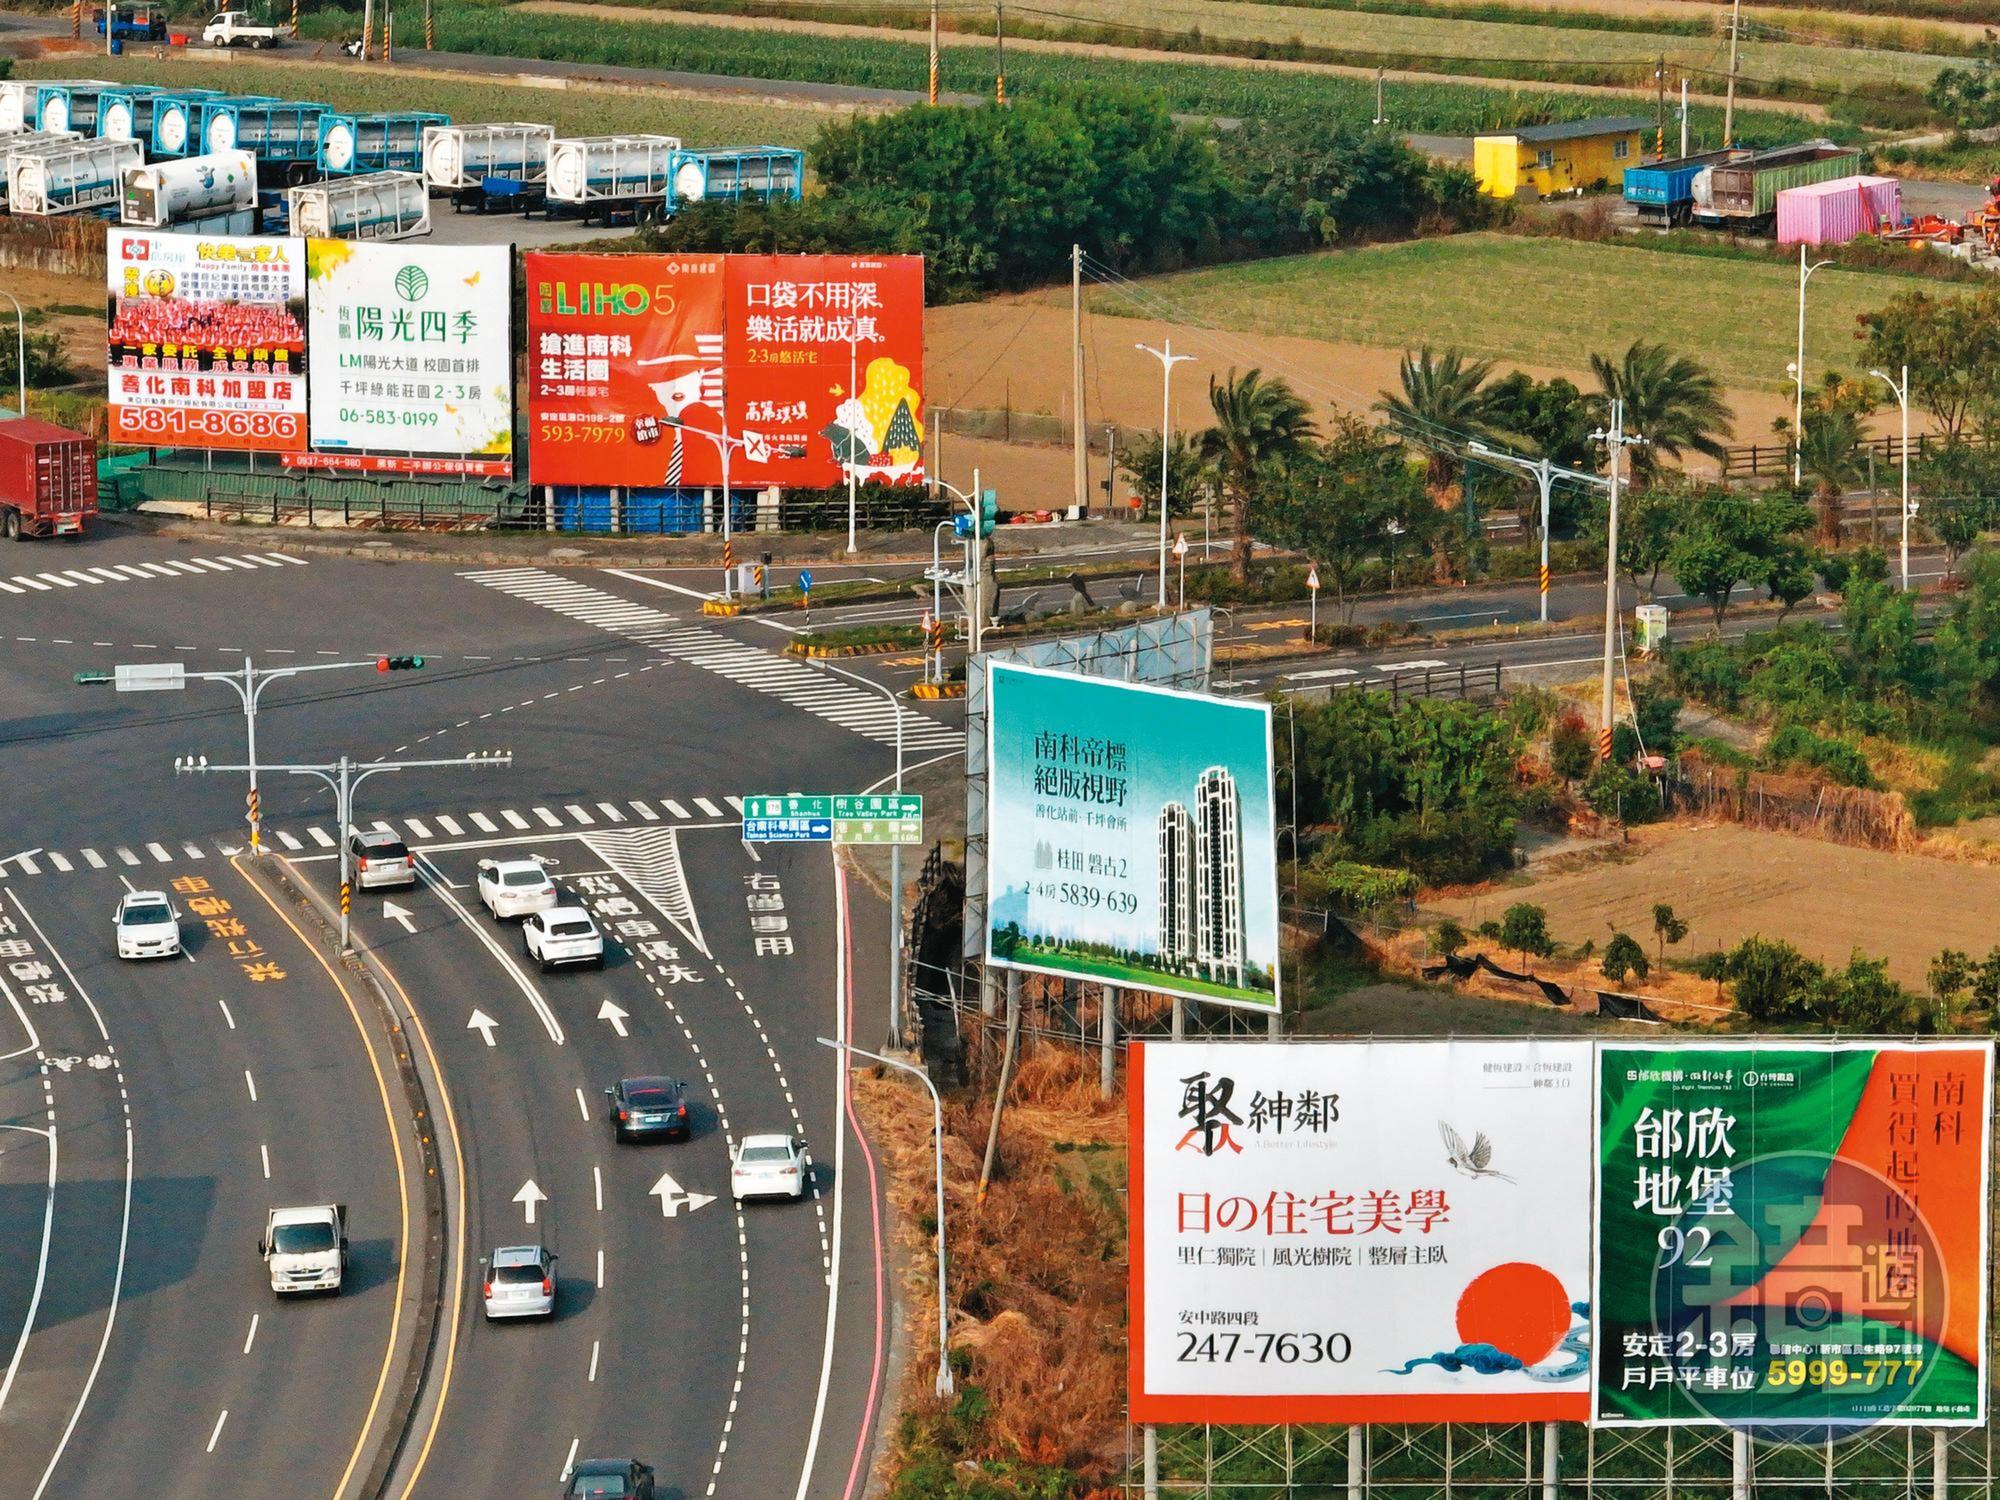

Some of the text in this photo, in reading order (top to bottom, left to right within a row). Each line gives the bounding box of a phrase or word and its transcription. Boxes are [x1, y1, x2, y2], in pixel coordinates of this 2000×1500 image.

[195, 262, 219, 270] Happy
[221, 263, 247, 271] Family
[357, 306, 478, 344] 陽光四季
[123, 343, 198, 358] 一家委託
[540, 333, 632, 357] 搶進南科
[339, 353, 480, 373] LM陽光大道 校園首排
[540, 358, 609, 381] 生活圈
[121, 374, 292, 400] 善化南科加盟店
[119, 407, 297, 437] 581-8686
[339, 408, 438, 426] 06-583-0199
[541, 424, 625, 444] 593-7979
[1034, 730, 1126, 772] 南科帝標
[1034, 764, 1127, 807] 絕版視野
[836, 798, 899, 810] 樹谷園區
[856, 810, 878, 818] Valley
[746, 820, 810, 832] 台南科學園區
[1057, 848, 1083, 873] 桂田
[1060, 882, 1138, 915] 5839-639
[1245, 1089, 1341, 1135] 紳鄰
[1932, 1071, 1965, 1146] 南科
[1262, 1139, 1294, 1149] Better
[1297, 1139, 1338, 1149] Lifestyle
[1633, 1106, 1737, 1160] 邰欣
[1633, 1166, 1735, 1216] 地堡
[1178, 1188, 1451, 1236] 日の住宅美學
[1177, 1246, 1447, 1266] 里仁獨院 風光樹院 整層主臥
[1658, 1225, 1714, 1269] 92
[1178, 1310, 1259, 1326] 安中路四段
[1176, 1332, 1352, 1364] 247-7630
[1622, 1331, 1757, 1358] 安定2-3房
[1622, 1366, 1756, 1391] 戶戶平車位
[1767, 1360, 1923, 1386] 5999-777
